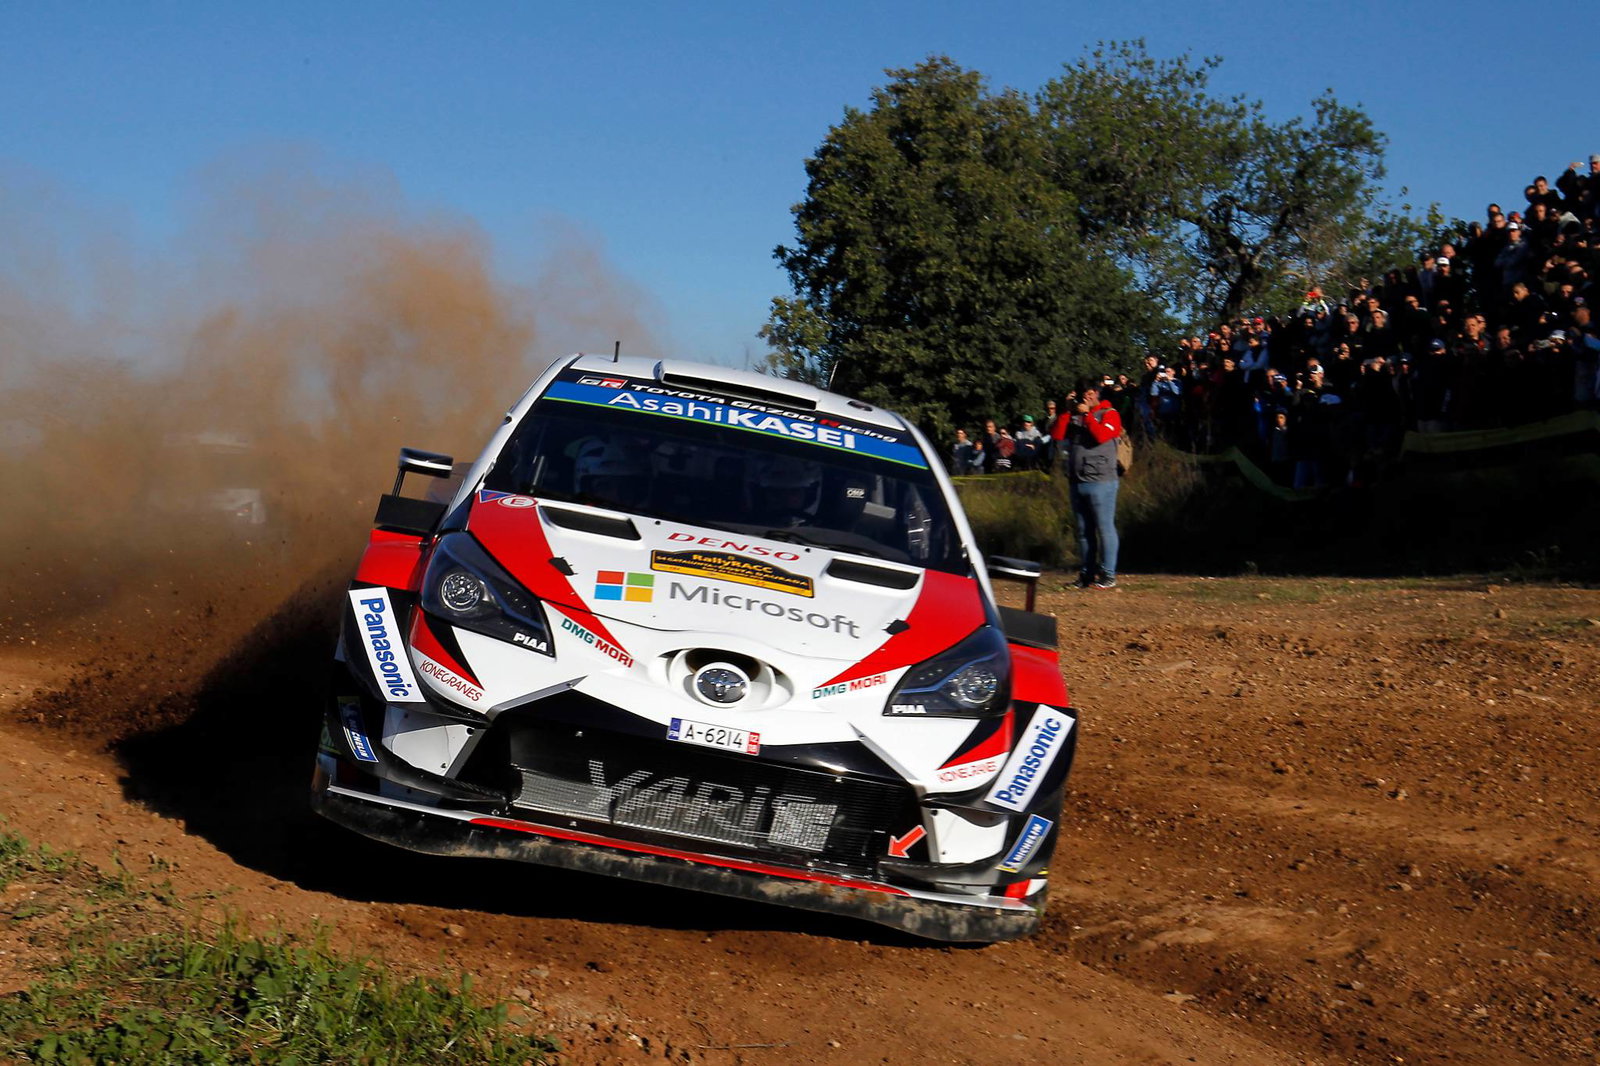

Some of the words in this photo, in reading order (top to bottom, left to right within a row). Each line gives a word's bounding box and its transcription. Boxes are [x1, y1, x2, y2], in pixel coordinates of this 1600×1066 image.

[580, 378, 623, 389] GR
[631, 384, 725, 404] TOYOTA
[731, 400, 816, 422] GAZOO
[819, 418, 897, 443] Racing
[667, 532, 800, 561] DENSO
[669, 581, 860, 639] Microsoft
[360, 597, 409, 698] Panasonic
[513, 632, 548, 652] PIAA
[561, 617, 594, 645] DMG
[595, 639, 634, 669] MORI
[420, 659, 484, 702] KONECRANES
[812, 683, 847, 700] DMG
[849, 673, 887, 691] MORI
[892, 704, 927, 714] PIAA
[684, 724, 743, 748] A-6214
[994, 718, 1061, 805] Panasonic
